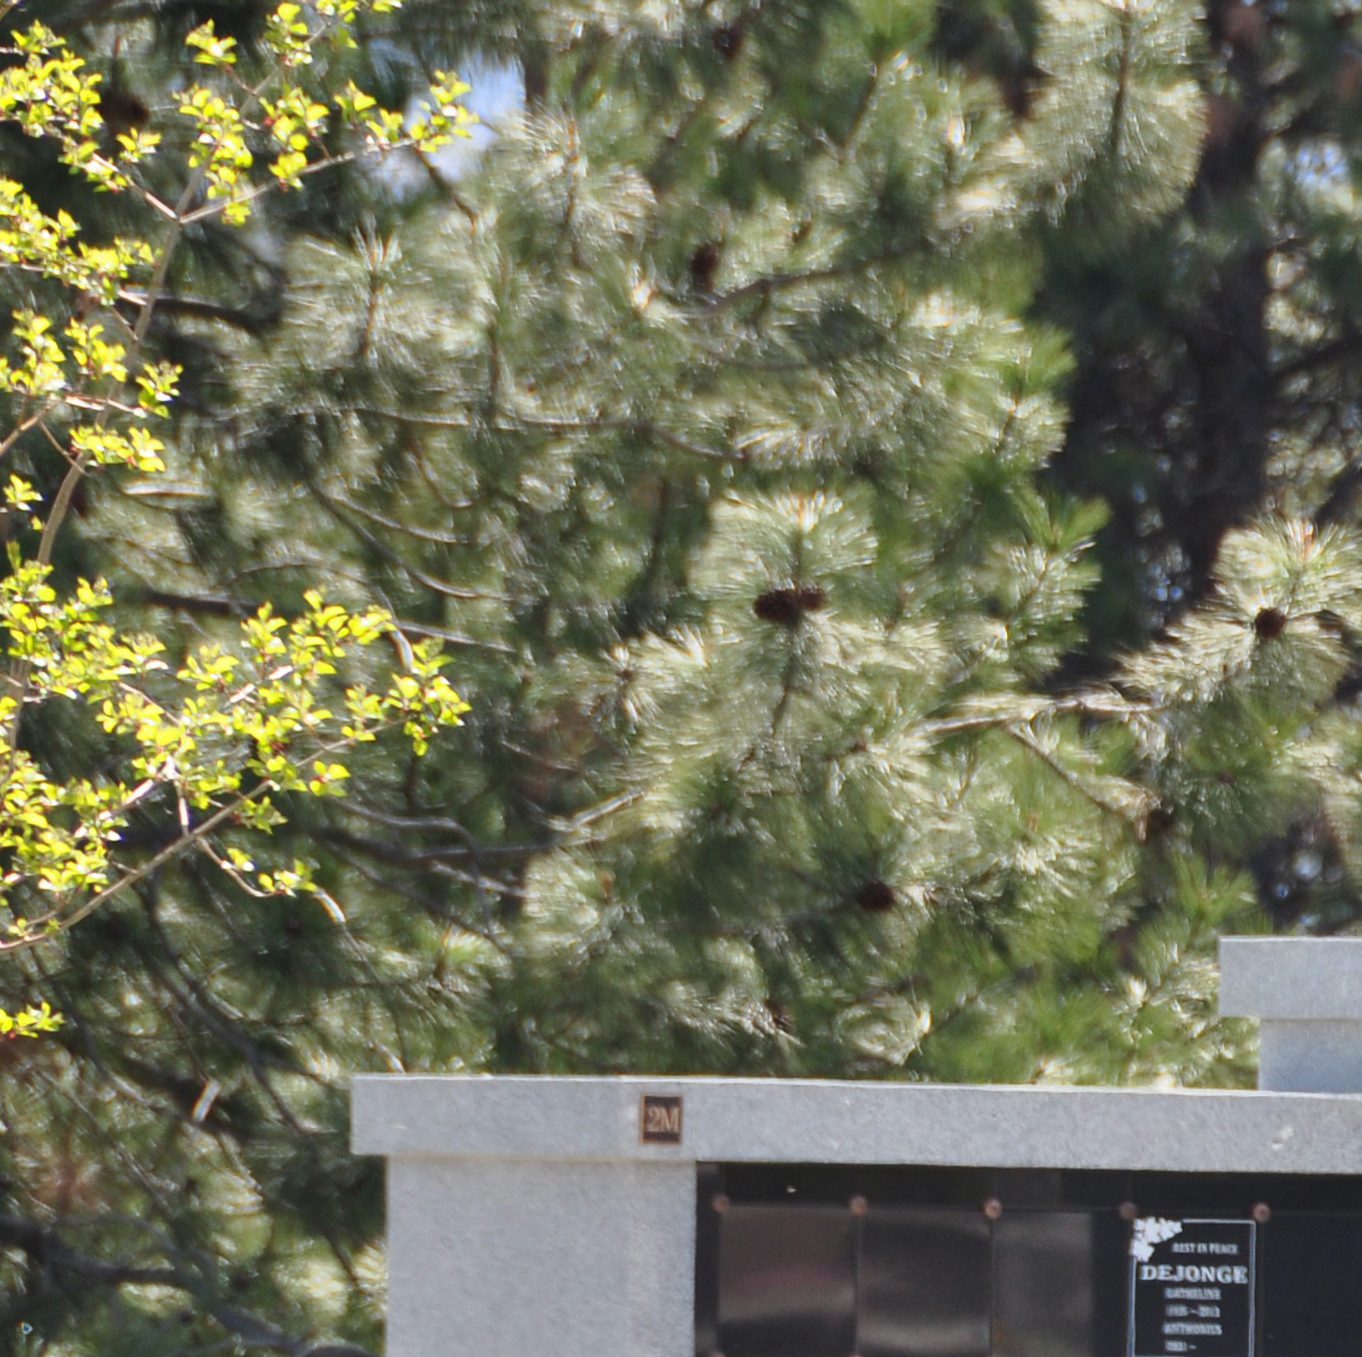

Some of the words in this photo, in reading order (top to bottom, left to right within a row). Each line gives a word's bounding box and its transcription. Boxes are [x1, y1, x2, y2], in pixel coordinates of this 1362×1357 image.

[648, 1106, 679, 1133] 2M
[1173, 1243, 1196, 1254] REST
[1197, 1244, 1208, 1254] IN
[1210, 1243, 1239, 1255] PEACE
[1141, 1264, 1249, 1284] DEJONGE
